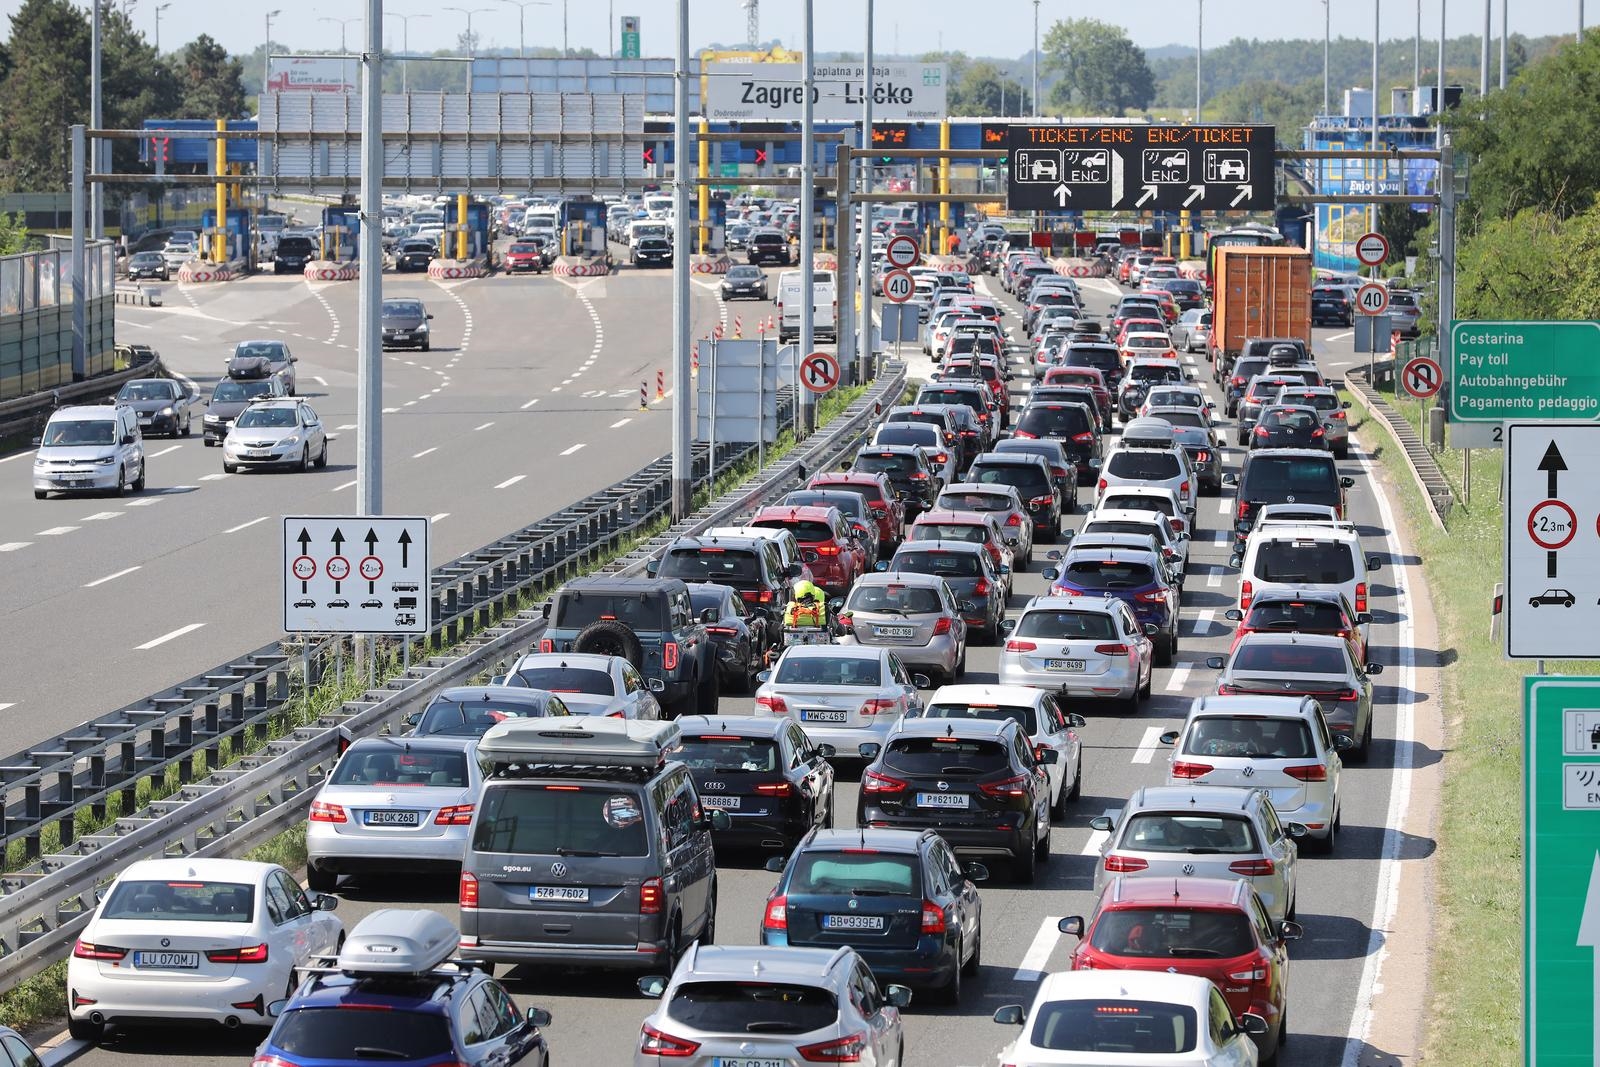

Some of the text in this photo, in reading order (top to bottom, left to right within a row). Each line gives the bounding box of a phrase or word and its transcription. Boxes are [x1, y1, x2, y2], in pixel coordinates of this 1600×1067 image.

[855, 66, 890, 77] potaja
[1028, 128, 1253, 143] TICKET/ENC ENC/TICKET
[1071, 170, 1100, 181] ENC
[1151, 170, 1180, 181] ENC
[890, 278, 908, 294] 40
[1363, 292, 1382, 307] 40
[1459, 332, 1524, 345] Cestarina
[1459, 353, 1509, 368] Pay toll
[1459, 374, 1567, 390] Autobahngebühr
[1459, 395, 1598, 411] Pagamento pedaggio
[398, 813, 414, 822] 268
[502, 865, 531, 873] egoe.eu
[561, 889, 585, 899] 7602
